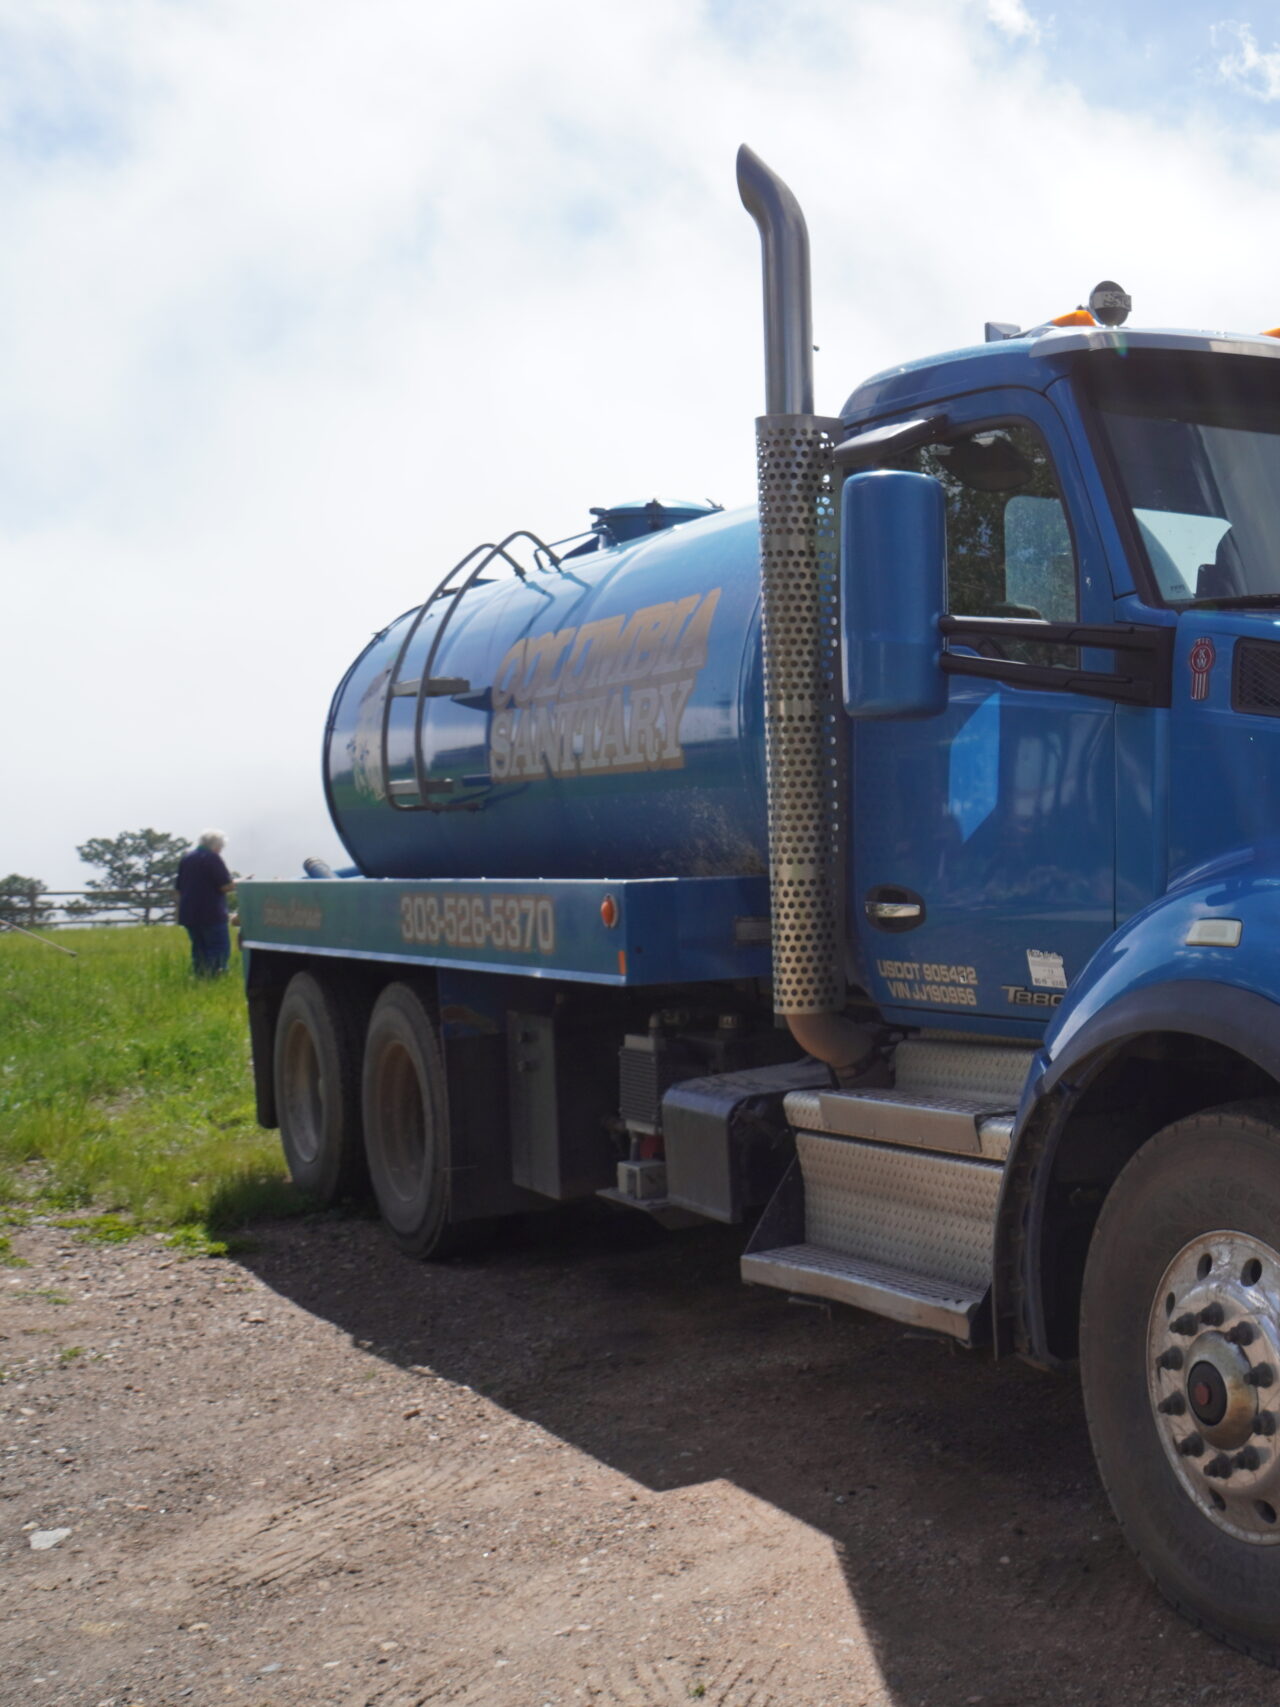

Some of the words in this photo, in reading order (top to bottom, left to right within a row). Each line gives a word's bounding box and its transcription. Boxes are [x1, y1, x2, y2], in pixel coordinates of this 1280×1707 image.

[490, 678, 695, 780] SANITARY
[400, 896, 554, 951] 303-526-5370
[876, 960, 920, 980] USDOT
[888, 980, 911, 1000] VIN
